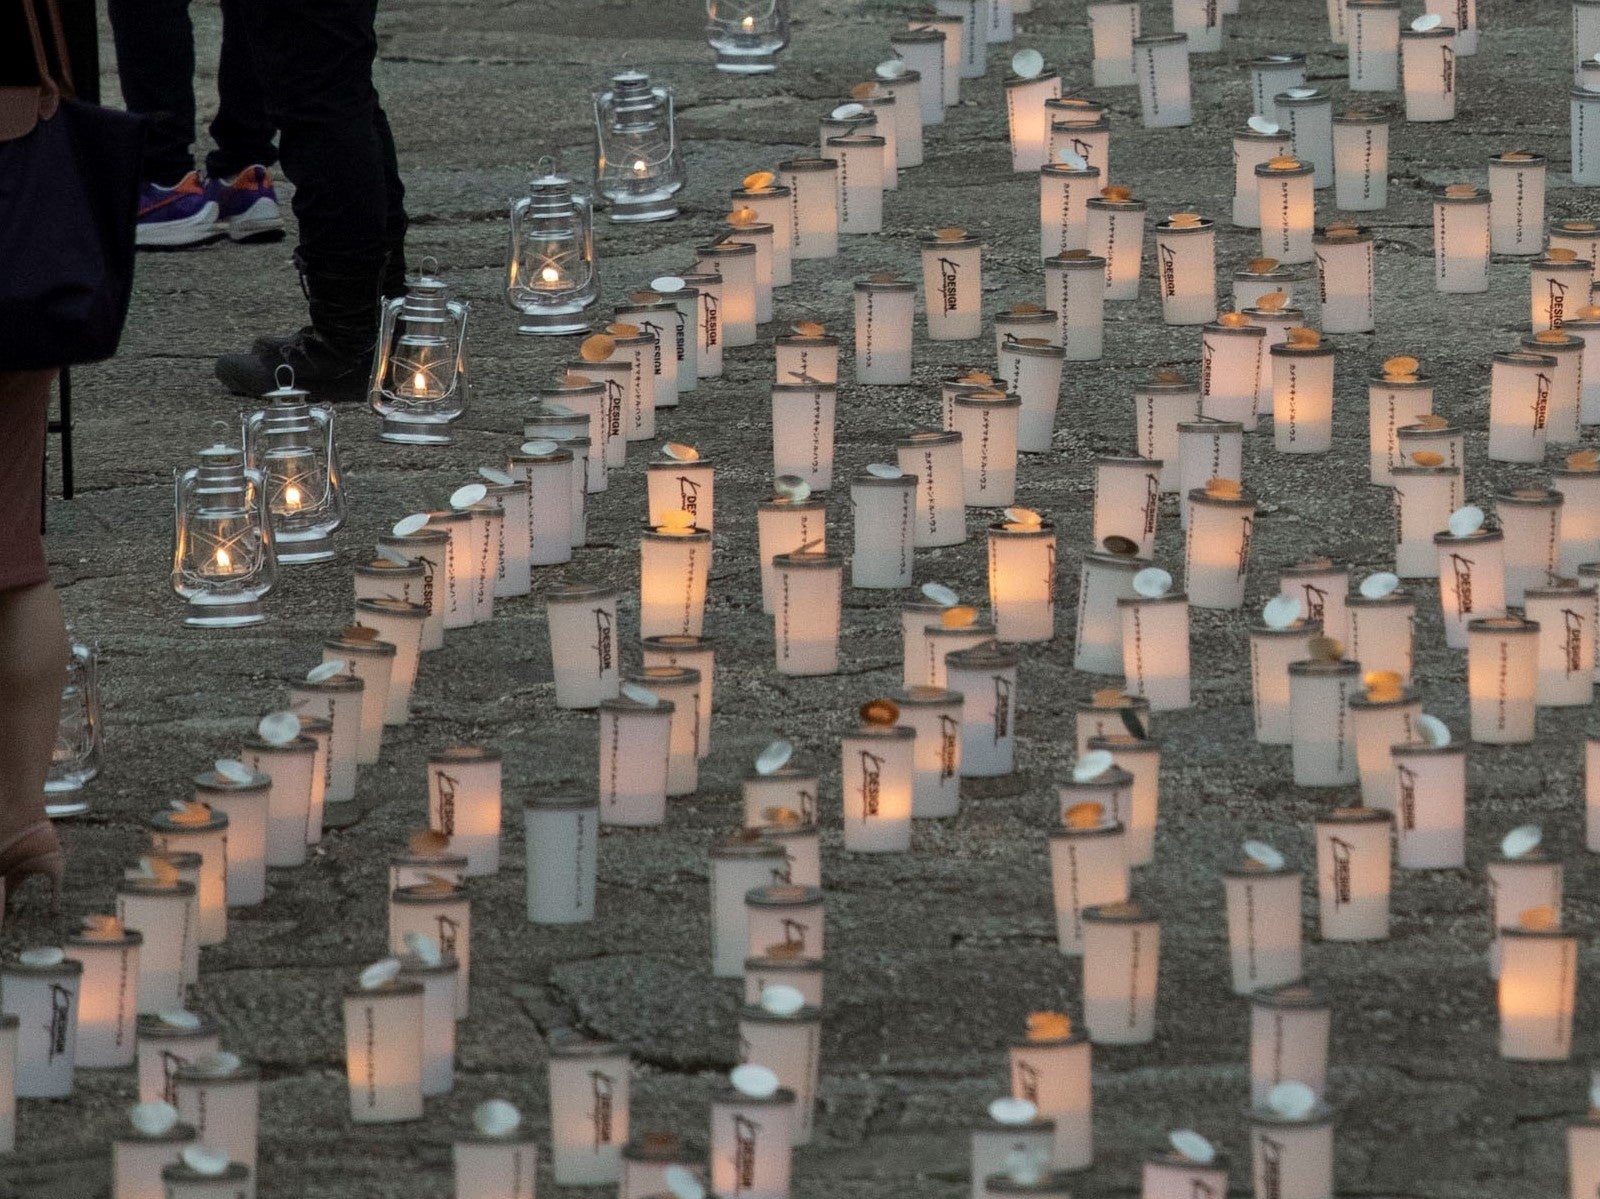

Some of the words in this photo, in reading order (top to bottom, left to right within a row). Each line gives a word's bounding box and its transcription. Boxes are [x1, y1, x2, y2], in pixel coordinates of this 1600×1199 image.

[947, 274, 957, 311] DESIGN
[1165, 260, 1174, 297] DESIGN
[1318, 269, 1326, 304] DESIGN
[709, 308, 718, 346] DESIGN
[612, 397, 620, 437] DESIGN
[1537, 391, 1548, 430] DESIGN
[603, 627, 612, 670] DESIGN
